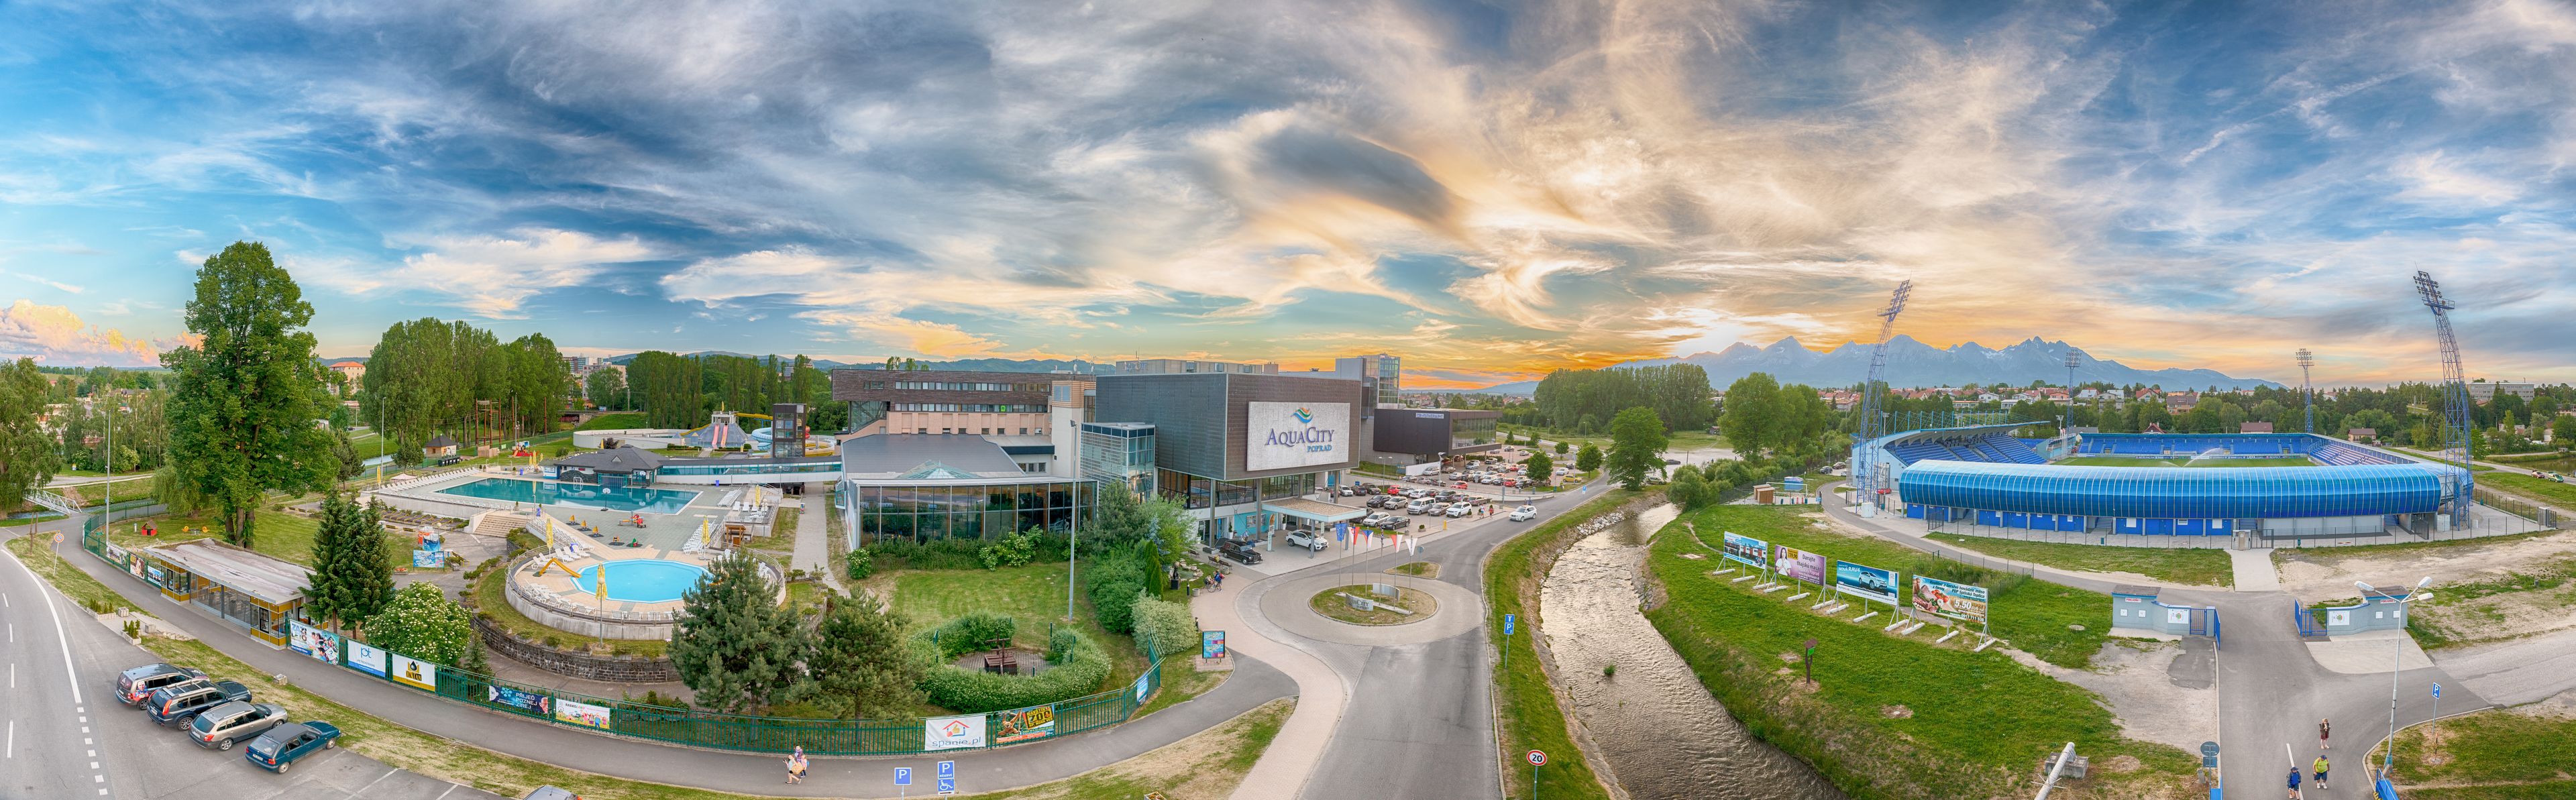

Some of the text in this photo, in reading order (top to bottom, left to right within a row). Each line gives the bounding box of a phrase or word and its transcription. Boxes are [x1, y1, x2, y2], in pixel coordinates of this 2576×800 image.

[1307, 445, 1332, 453] POPRAD
[361, 647, 372, 658] pt
[2434, 685, 2439, 693] P
[516, 697, 537, 706] POZNEJ
[1029, 711, 1051, 724] ZOO
[932, 737, 981, 748] spanie.pl
[1532, 754, 1543, 762] 20
[942, 763, 951, 773] P
[899, 769, 908, 779] P
